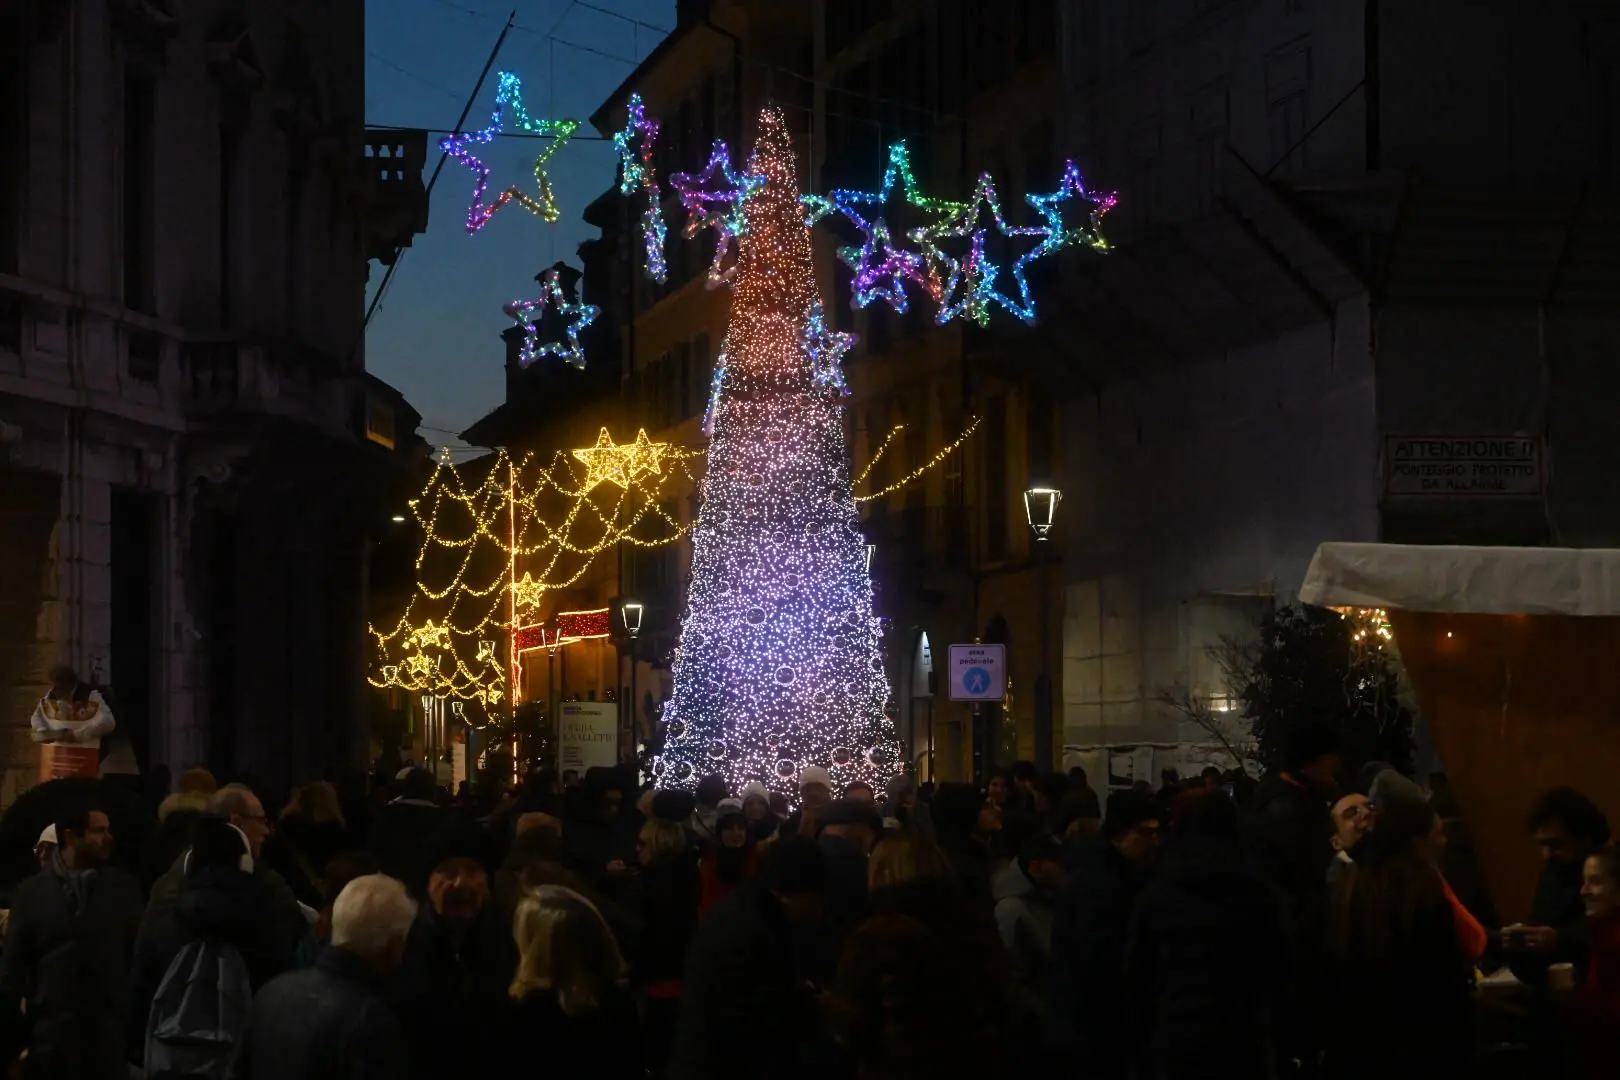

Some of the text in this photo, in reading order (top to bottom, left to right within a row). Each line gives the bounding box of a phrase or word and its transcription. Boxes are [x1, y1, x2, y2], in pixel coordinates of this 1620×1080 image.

[1395, 440, 1516, 456] ATTENZIONE
[1394, 464, 1535, 476] PONTEGGIO PROTETTO
[1421, 479, 1439, 489] DA
